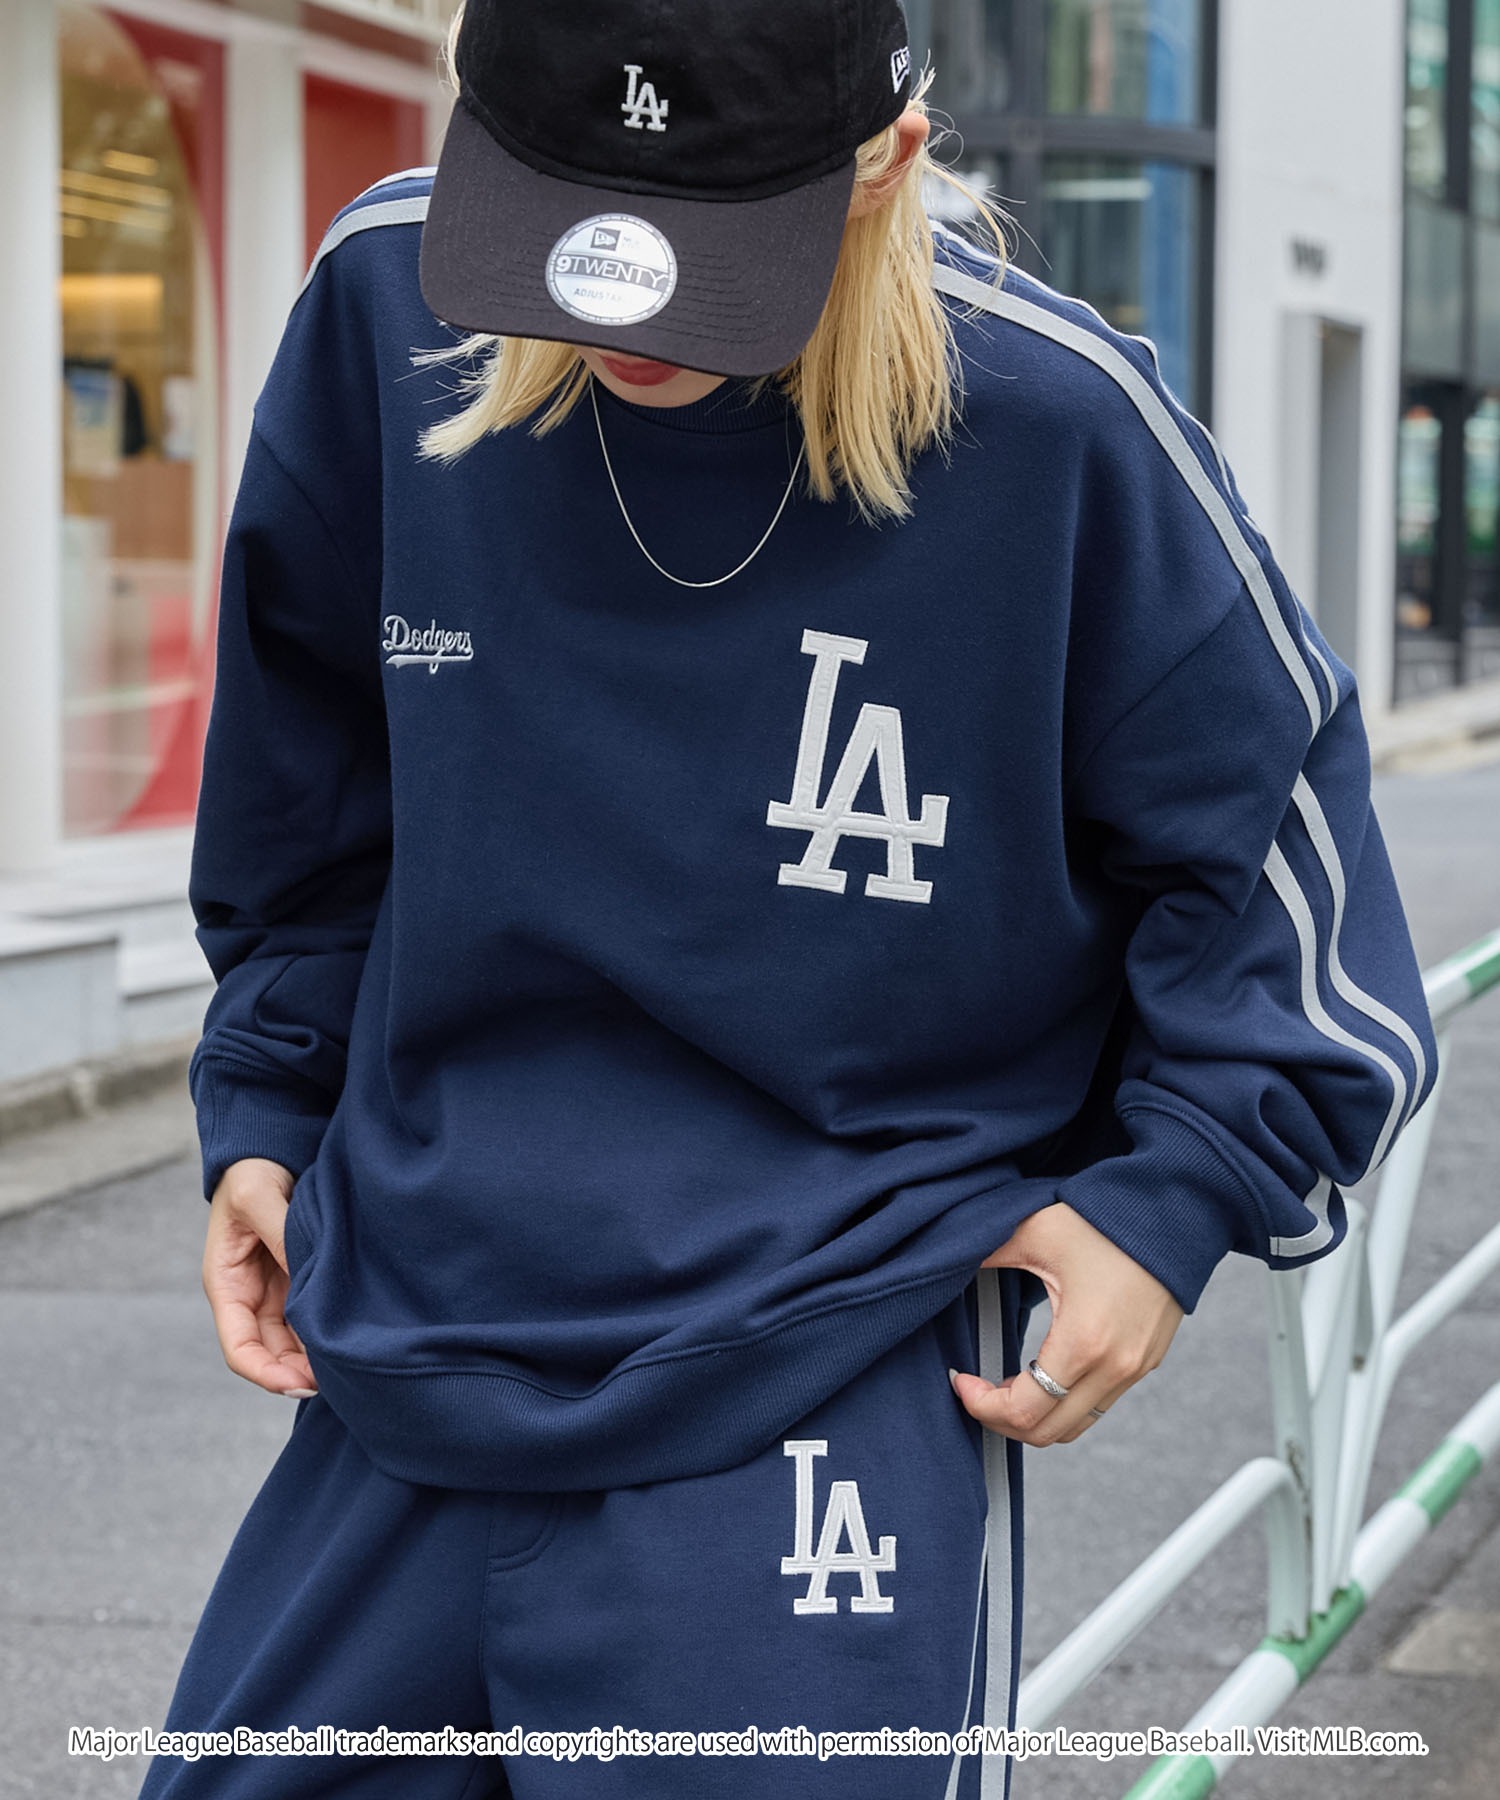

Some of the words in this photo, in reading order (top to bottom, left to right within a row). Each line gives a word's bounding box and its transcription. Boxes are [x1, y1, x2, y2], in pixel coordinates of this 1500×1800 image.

[621, 64, 669, 132] LA
[555, 255, 669, 289] 9TWENTY
[382, 614, 474, 675] Dodgers
[766, 628, 949, 904] LA
[780, 1439, 897, 1615] LA
